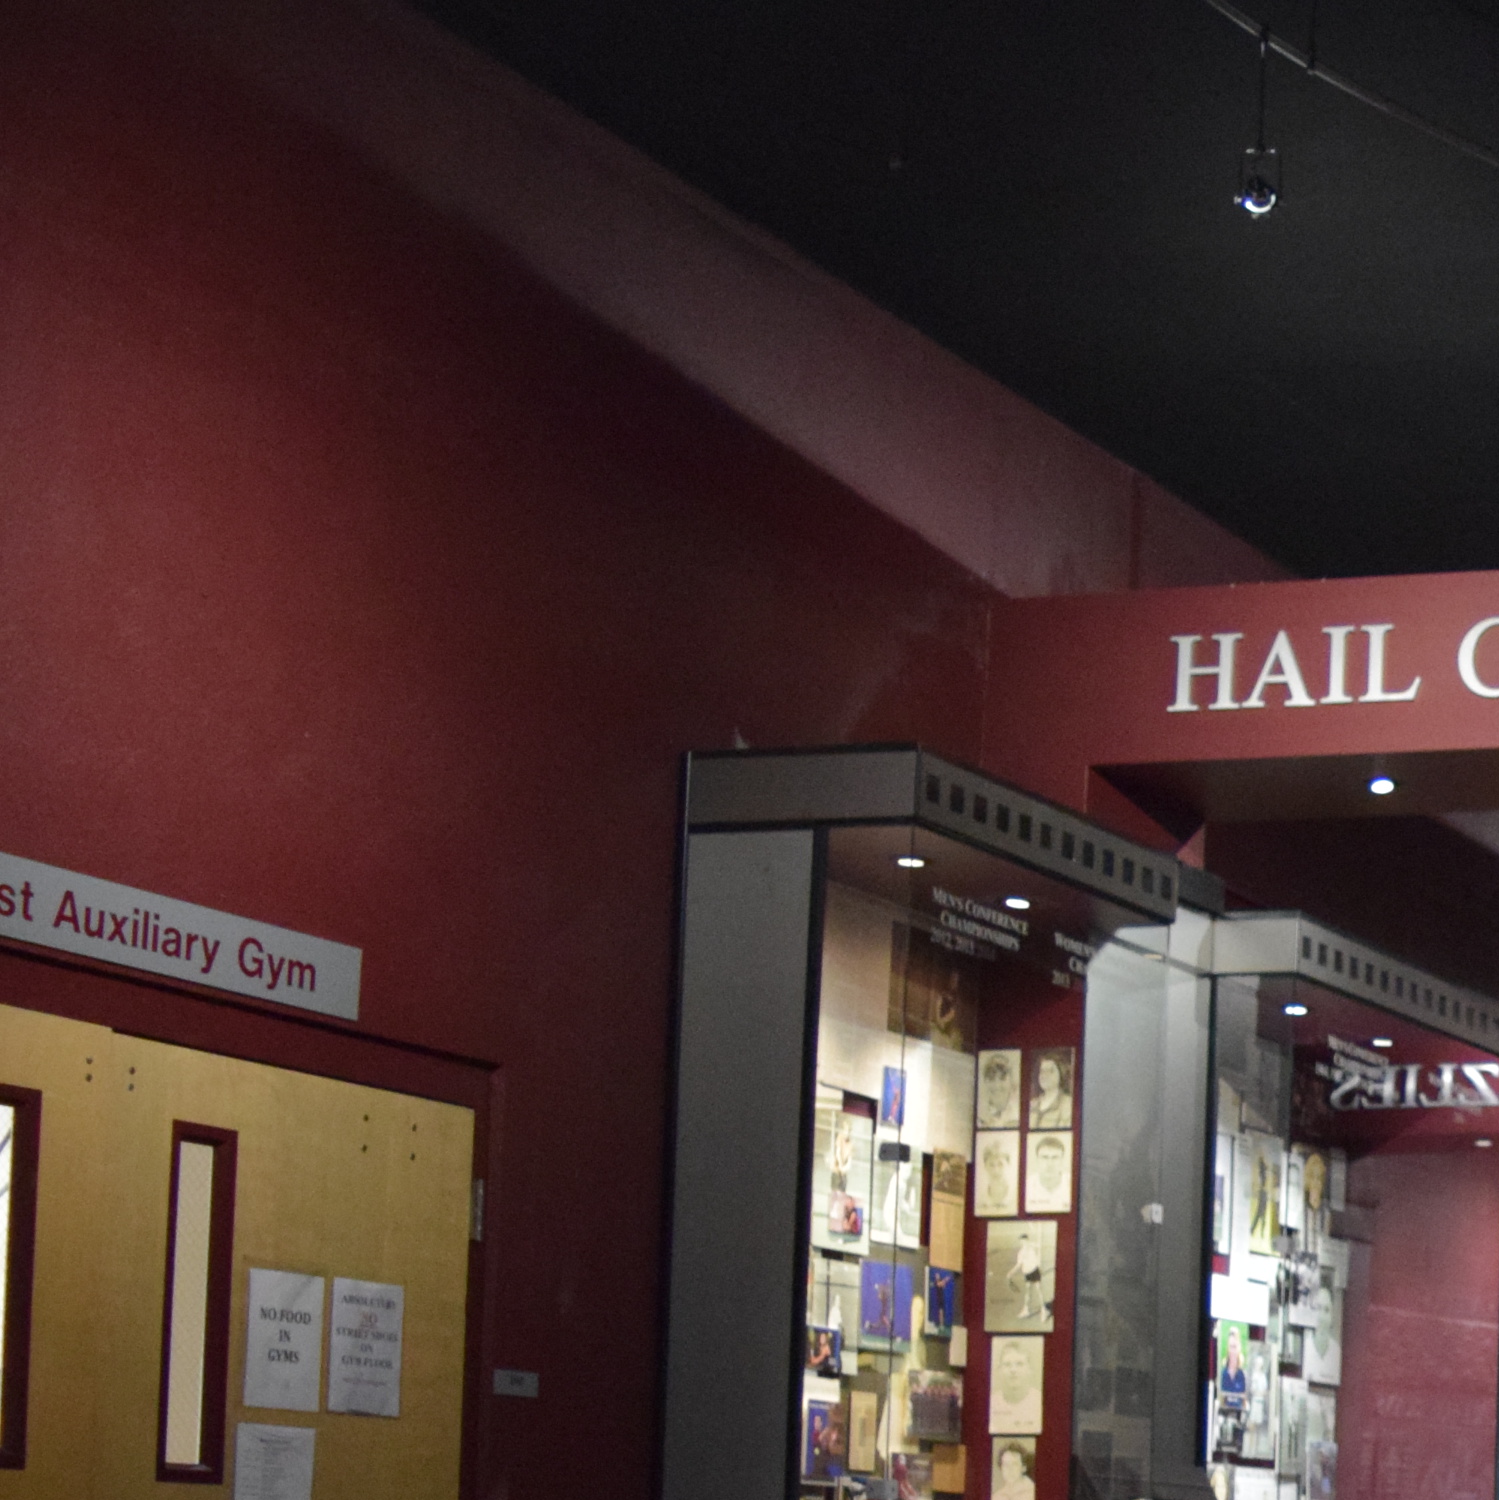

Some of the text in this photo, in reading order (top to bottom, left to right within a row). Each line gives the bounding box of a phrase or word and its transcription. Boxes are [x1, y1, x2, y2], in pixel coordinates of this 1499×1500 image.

[1167, 623, 1421, 712] HAIL
[53, 890, 220, 974] Auxiliary
[237, 937, 316, 992] Gym
[260, 1306, 312, 1325] NO FOOD
[278, 1329, 291, 1342] IN
[267, 1349, 300, 1363] GYMS
